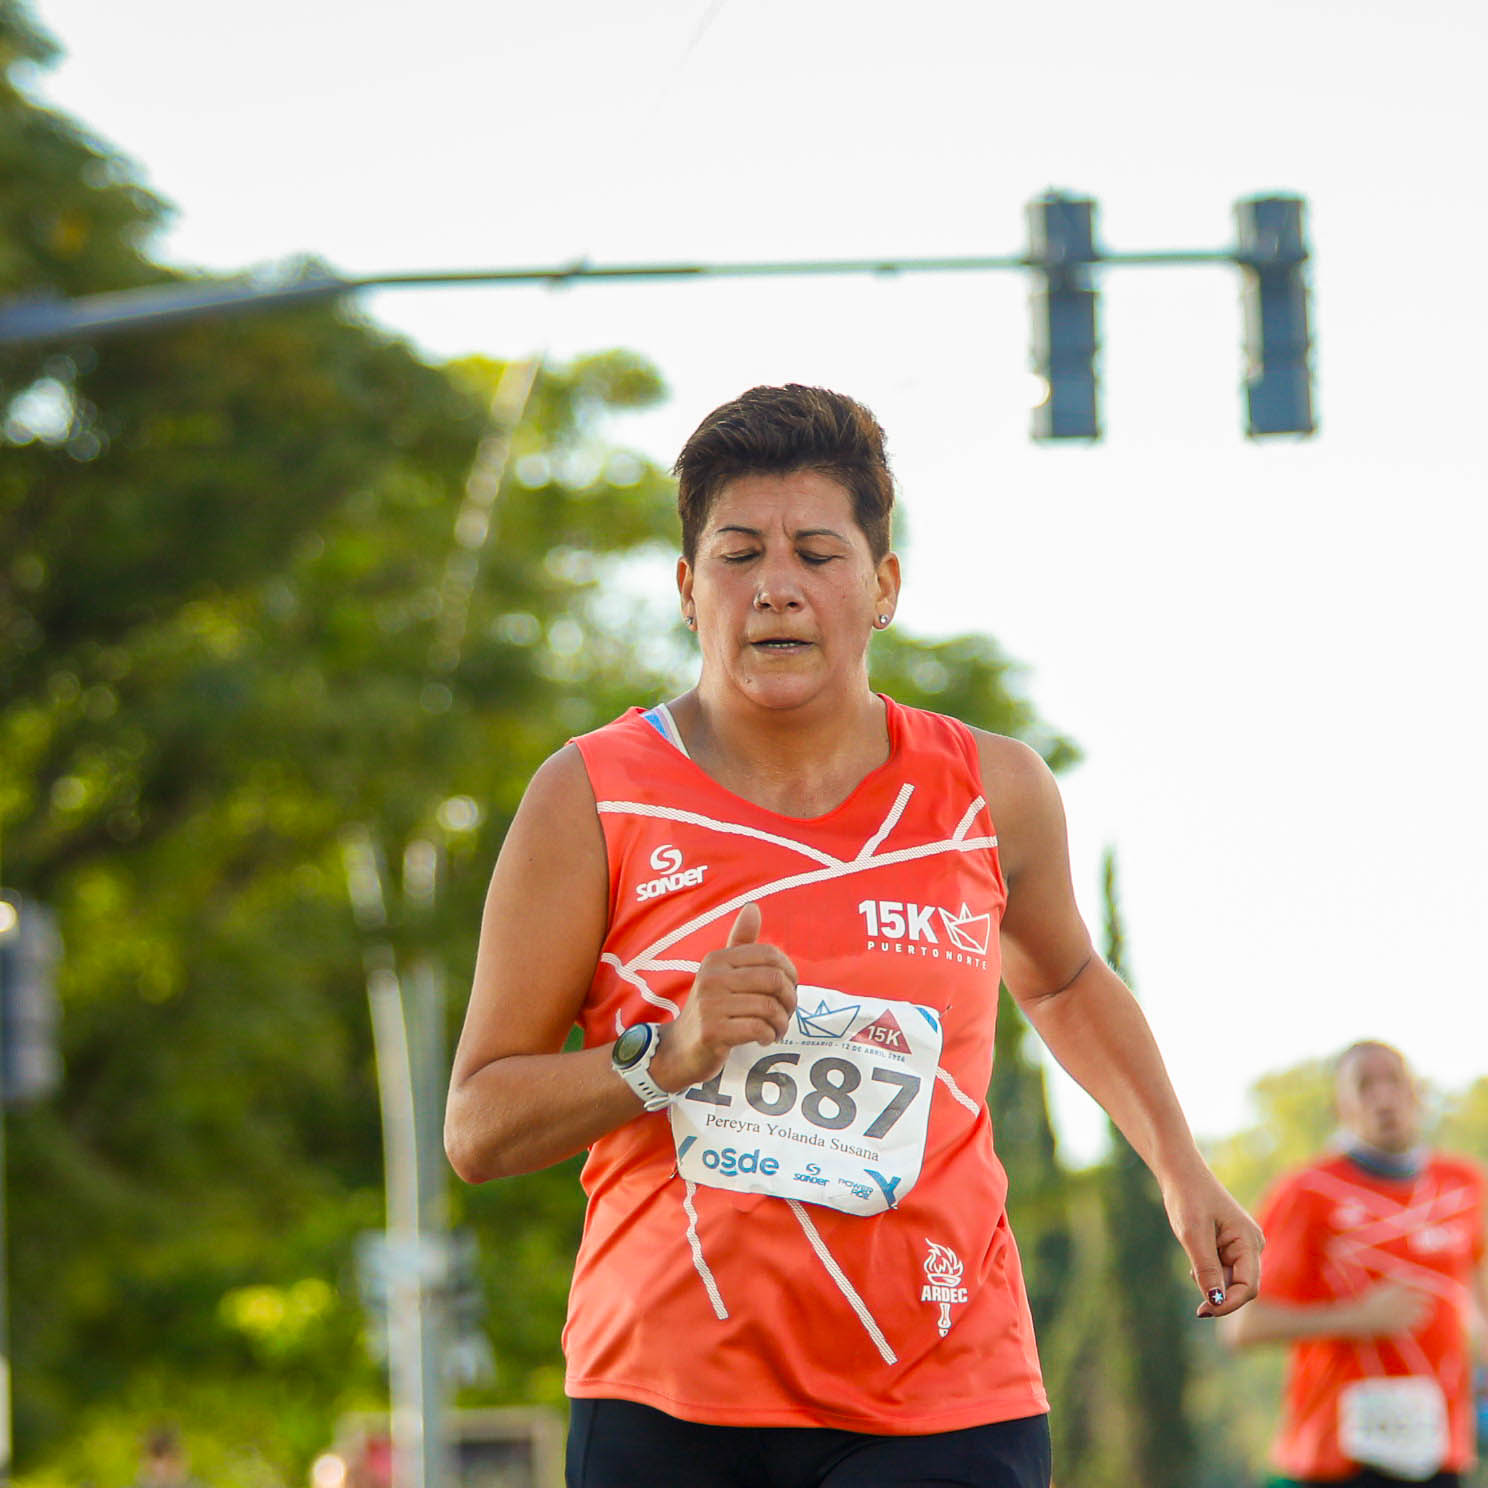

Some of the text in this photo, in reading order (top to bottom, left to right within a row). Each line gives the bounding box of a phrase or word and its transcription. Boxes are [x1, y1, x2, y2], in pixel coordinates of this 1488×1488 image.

[858, 899, 939, 943] 15K
[867, 941, 988, 970] PUERTO NORTE
[867, 1024, 903, 1047] 15K
[705, 1113, 880, 1162] Pereyra Yolanda Susana
[702, 1147, 780, 1177] osde
[921, 1285, 968, 1303] ARDEC
